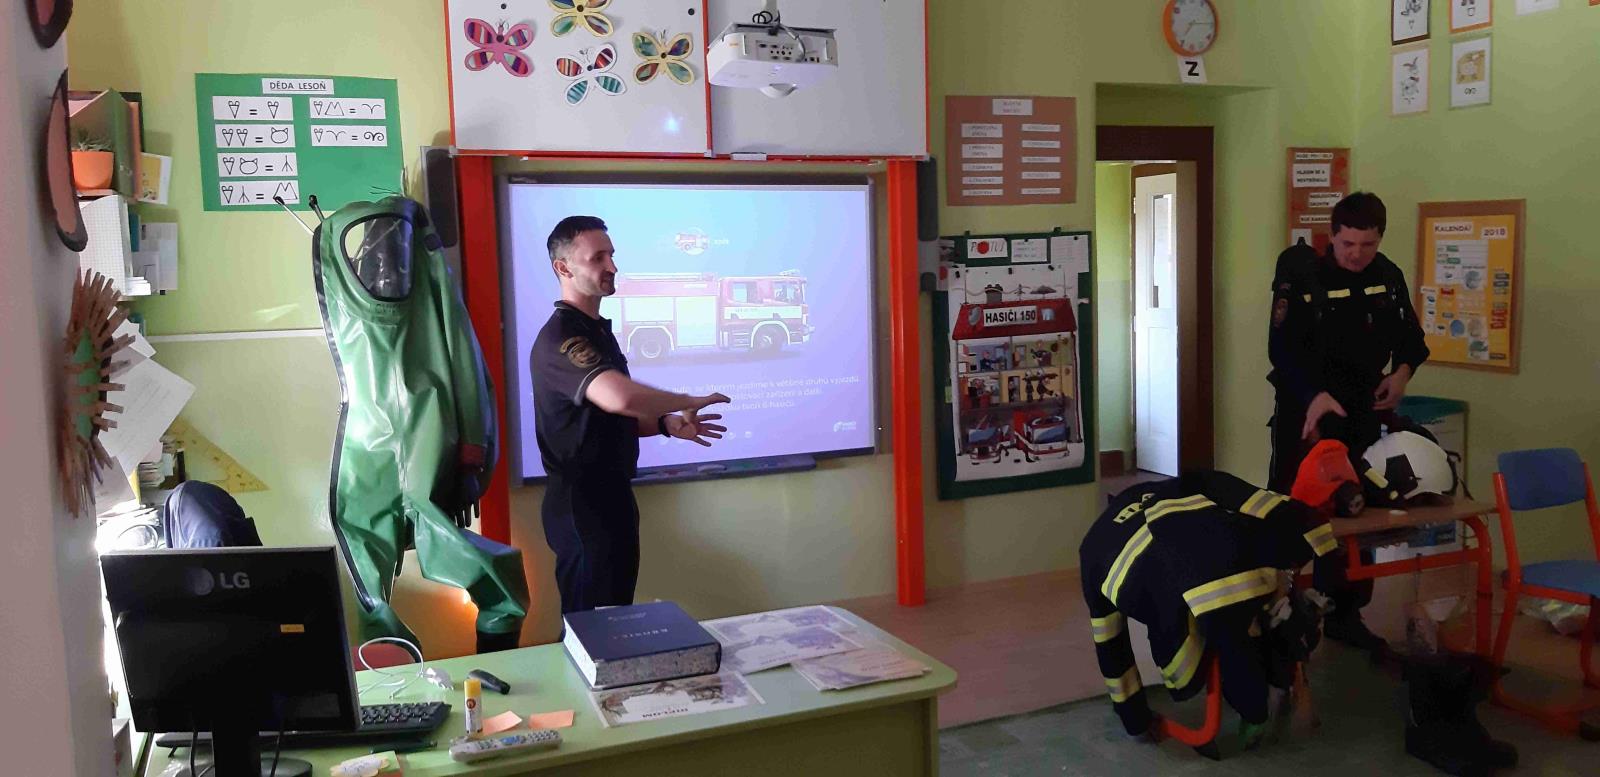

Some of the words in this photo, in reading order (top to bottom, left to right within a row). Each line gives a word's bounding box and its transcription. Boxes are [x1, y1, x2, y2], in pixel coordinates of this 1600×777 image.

[1185, 61, 1199, 76] Z
[270, 80, 294, 90] DĚDA
[298, 80, 326, 90] LESOŇ
[1484, 228, 1505, 236] 2018
[985, 309, 1017, 324] HASIČI
[1020, 309, 1036, 321] 150
[220, 572, 250, 588] LG
